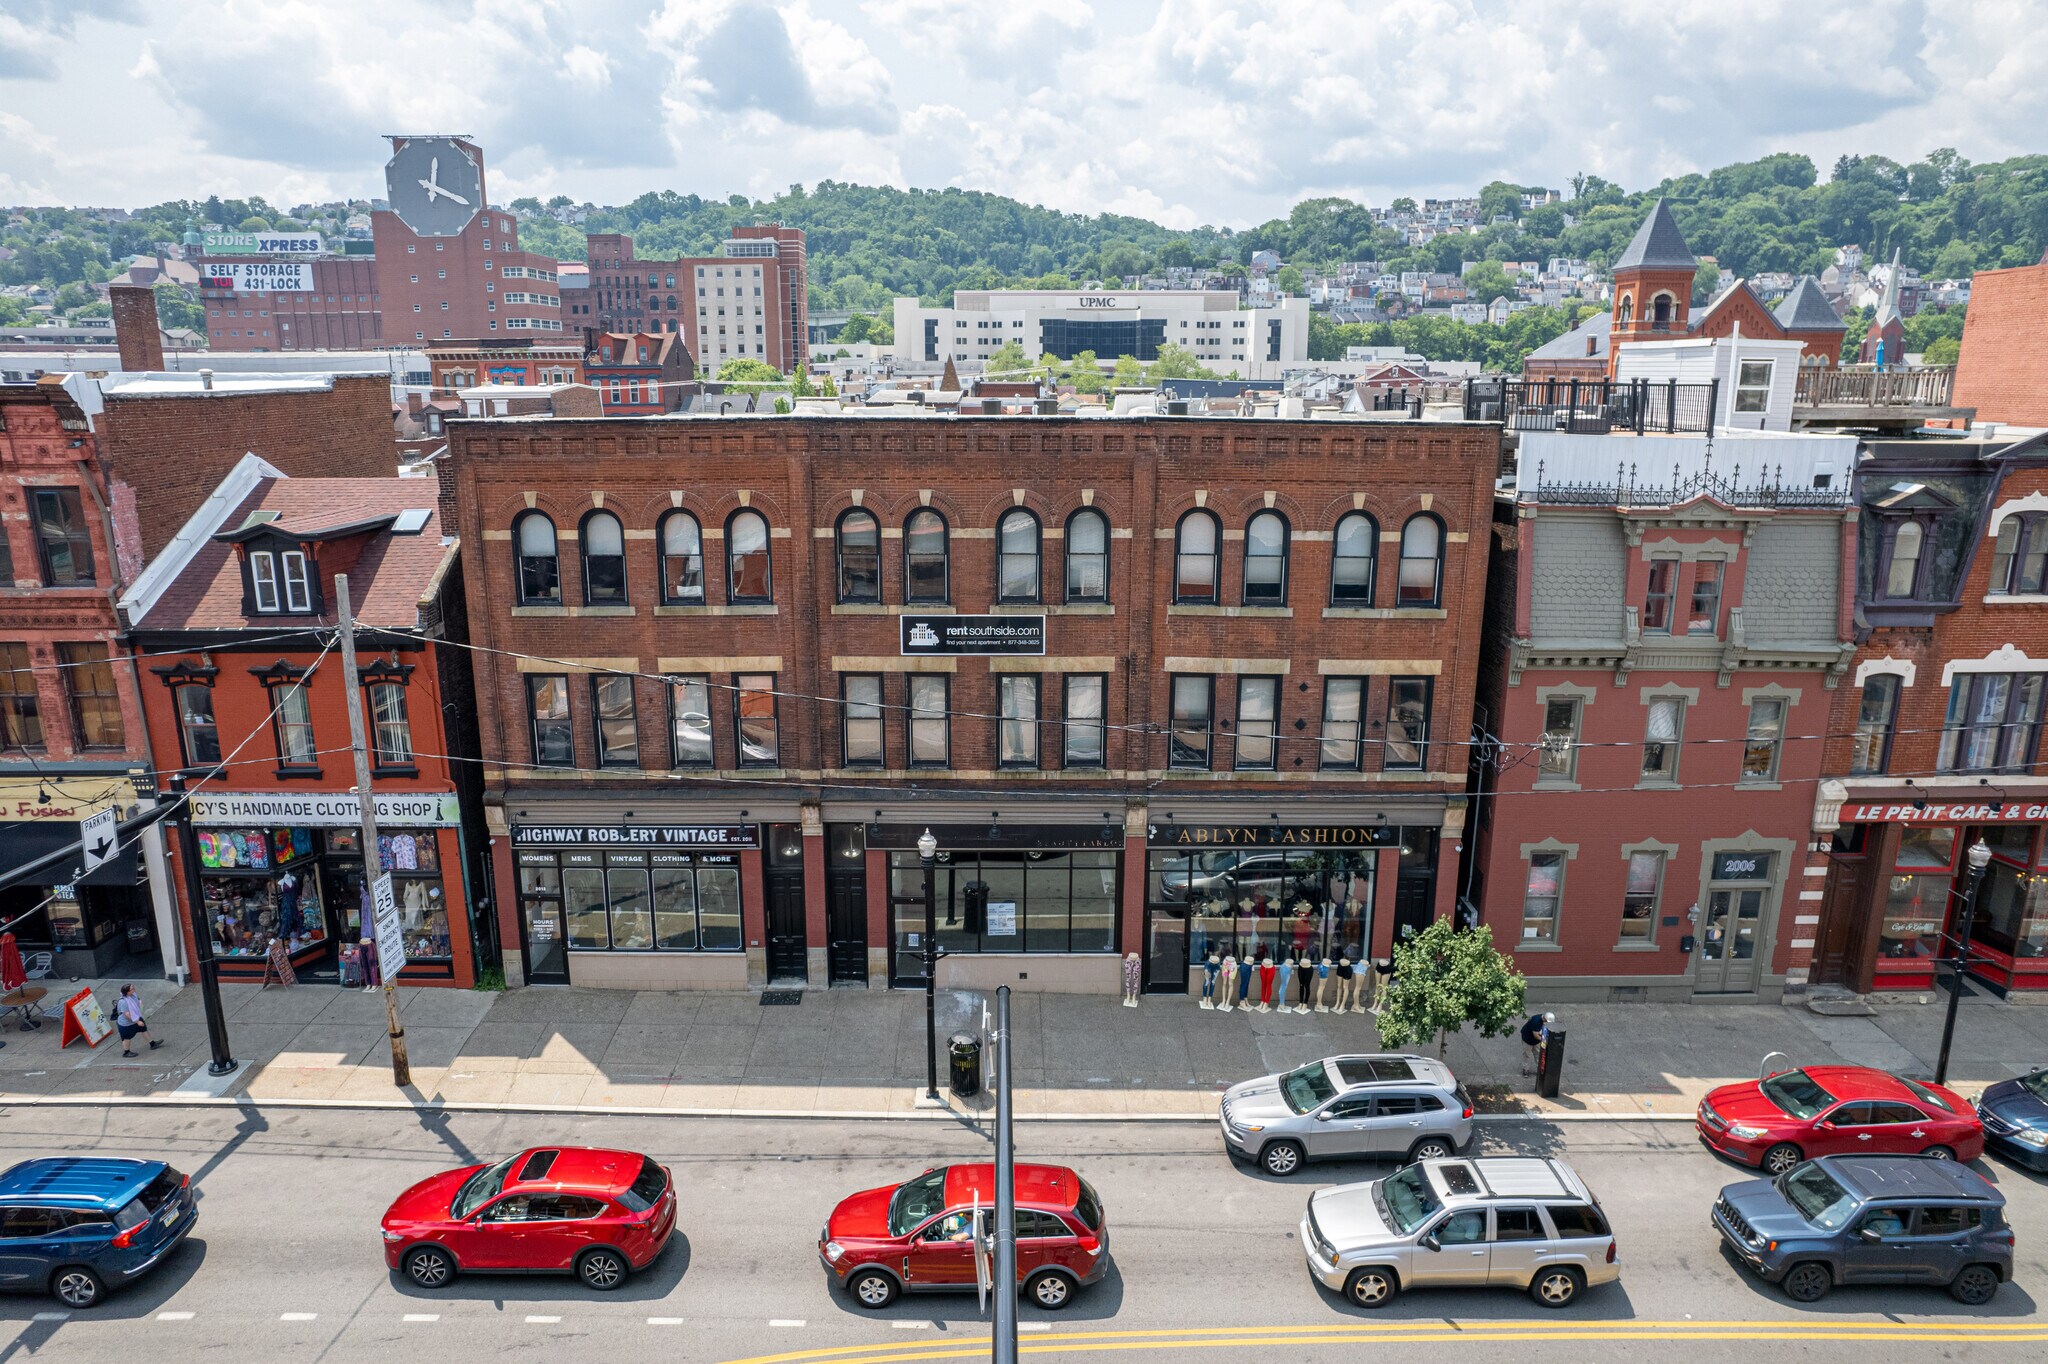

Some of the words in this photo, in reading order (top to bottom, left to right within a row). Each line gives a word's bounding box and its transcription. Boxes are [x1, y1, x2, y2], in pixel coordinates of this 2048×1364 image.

[207, 235, 254, 246] STORE
[259, 240, 318, 251] XPRESS
[210, 265, 239, 276] SELF
[246, 265, 301, 276] STORAGE
[244, 278, 301, 289] 431-LOCK
[1080, 298, 1116, 307] UPMC
[189, 802, 228, 816] CY'S
[231, 802, 313, 816] HANDMADE
[316, 802, 389, 816] CLOTHNG
[392, 802, 431, 816] SHOP
[1854, 806, 1883, 820] LE
[1884, 806, 1946, 820] PETIT
[2005, 805, 2020, 819] &
[84, 812, 112, 832] PARKING
[663, 829, 728, 842] VINTAGE
[1177, 828, 1258, 843] ABLYN
[1725, 860, 1756, 871] 2006
[374, 877, 390, 892] SPEED
[377, 886, 389, 898] LIMIT
[377, 893, 392, 913] 25
[382, 919, 395, 932] SNOW
[384, 938, 398, 955] ROUTE
